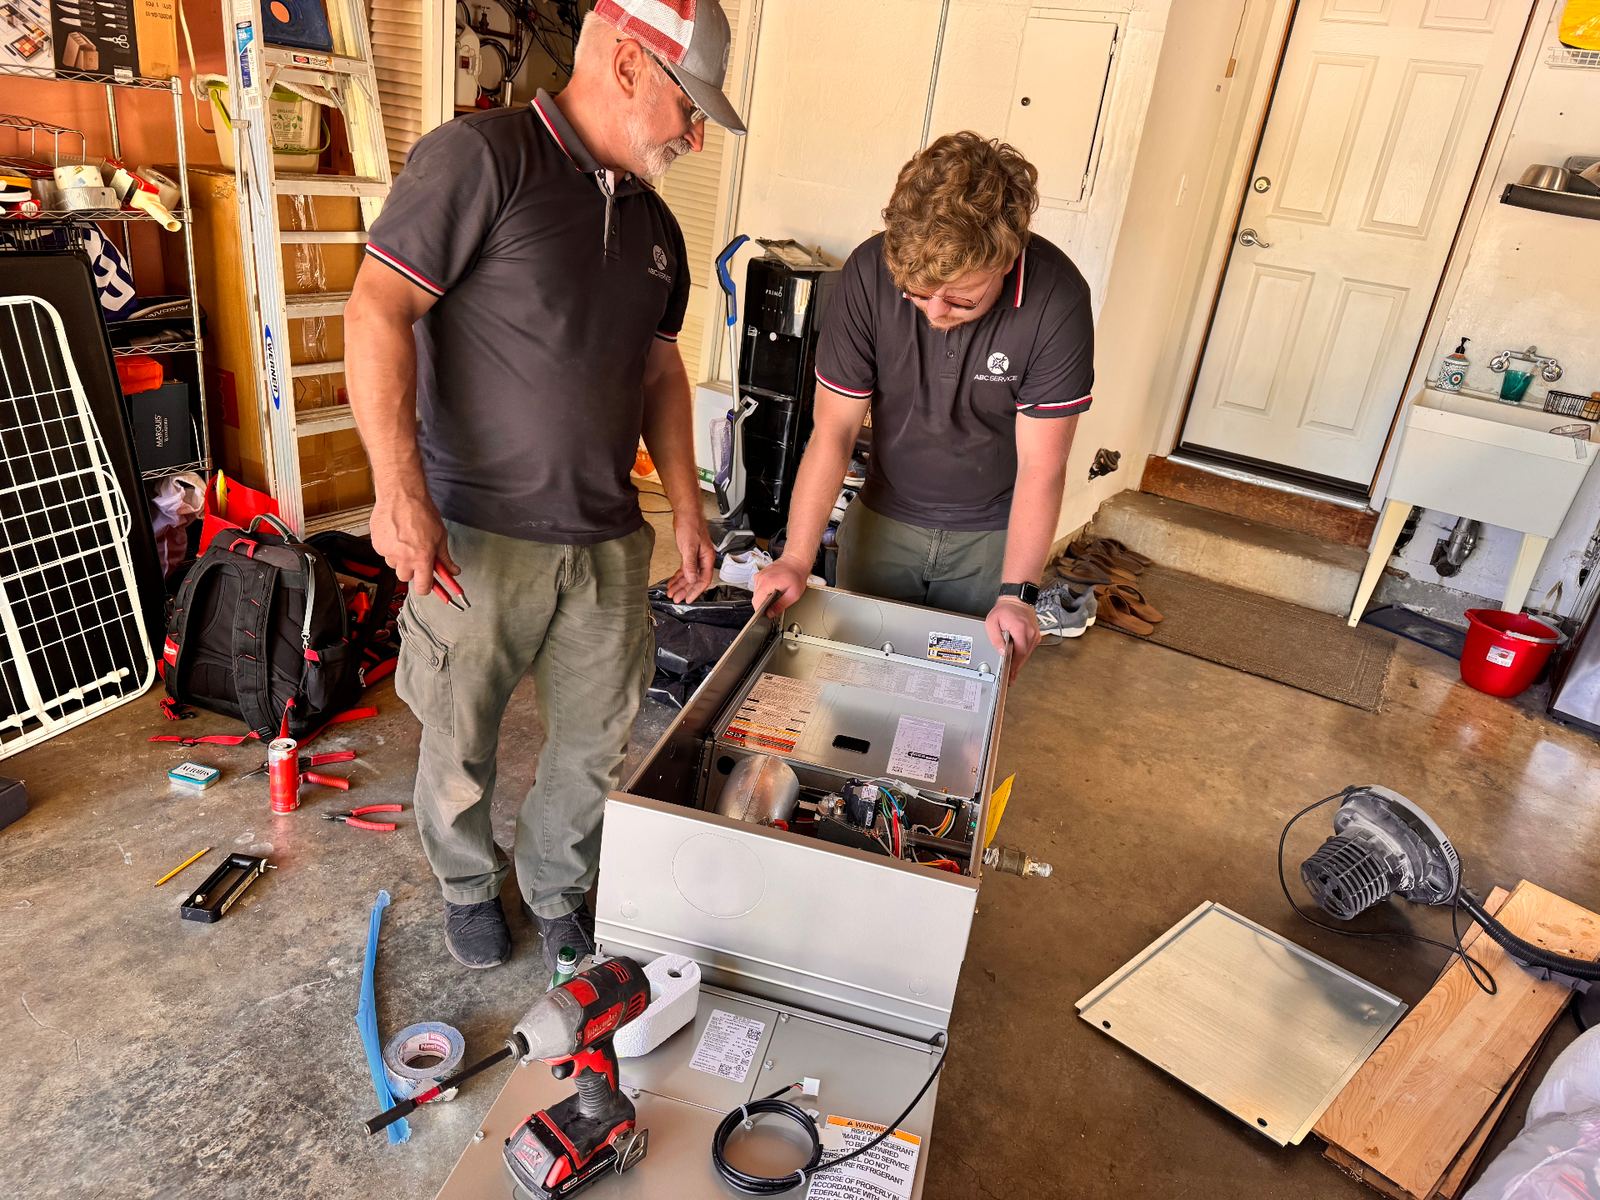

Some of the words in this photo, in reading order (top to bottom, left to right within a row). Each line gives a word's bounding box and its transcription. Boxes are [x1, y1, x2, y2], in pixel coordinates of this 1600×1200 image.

[267, 342, 278, 393] WERNER
[990, 374, 1018, 382] SERVICE
[154, 414, 163, 448] MARQUIS
[855, 1122, 888, 1132] WARNING
[870, 1144, 899, 1158] EPAIRED
[863, 1158, 874, 1167] DO
[876, 1162, 890, 1172] NOT
[881, 1155, 910, 1172] SERVICE
[856, 1162, 904, 1186] REFRIGERANT
[809, 1188, 842, 1199] FEDERAL
[812, 1180, 862, 1194] ACCORDANCE
[814, 1173, 844, 1184] DISPOSE
[856, 1178, 892, 1200] PROPERLY
